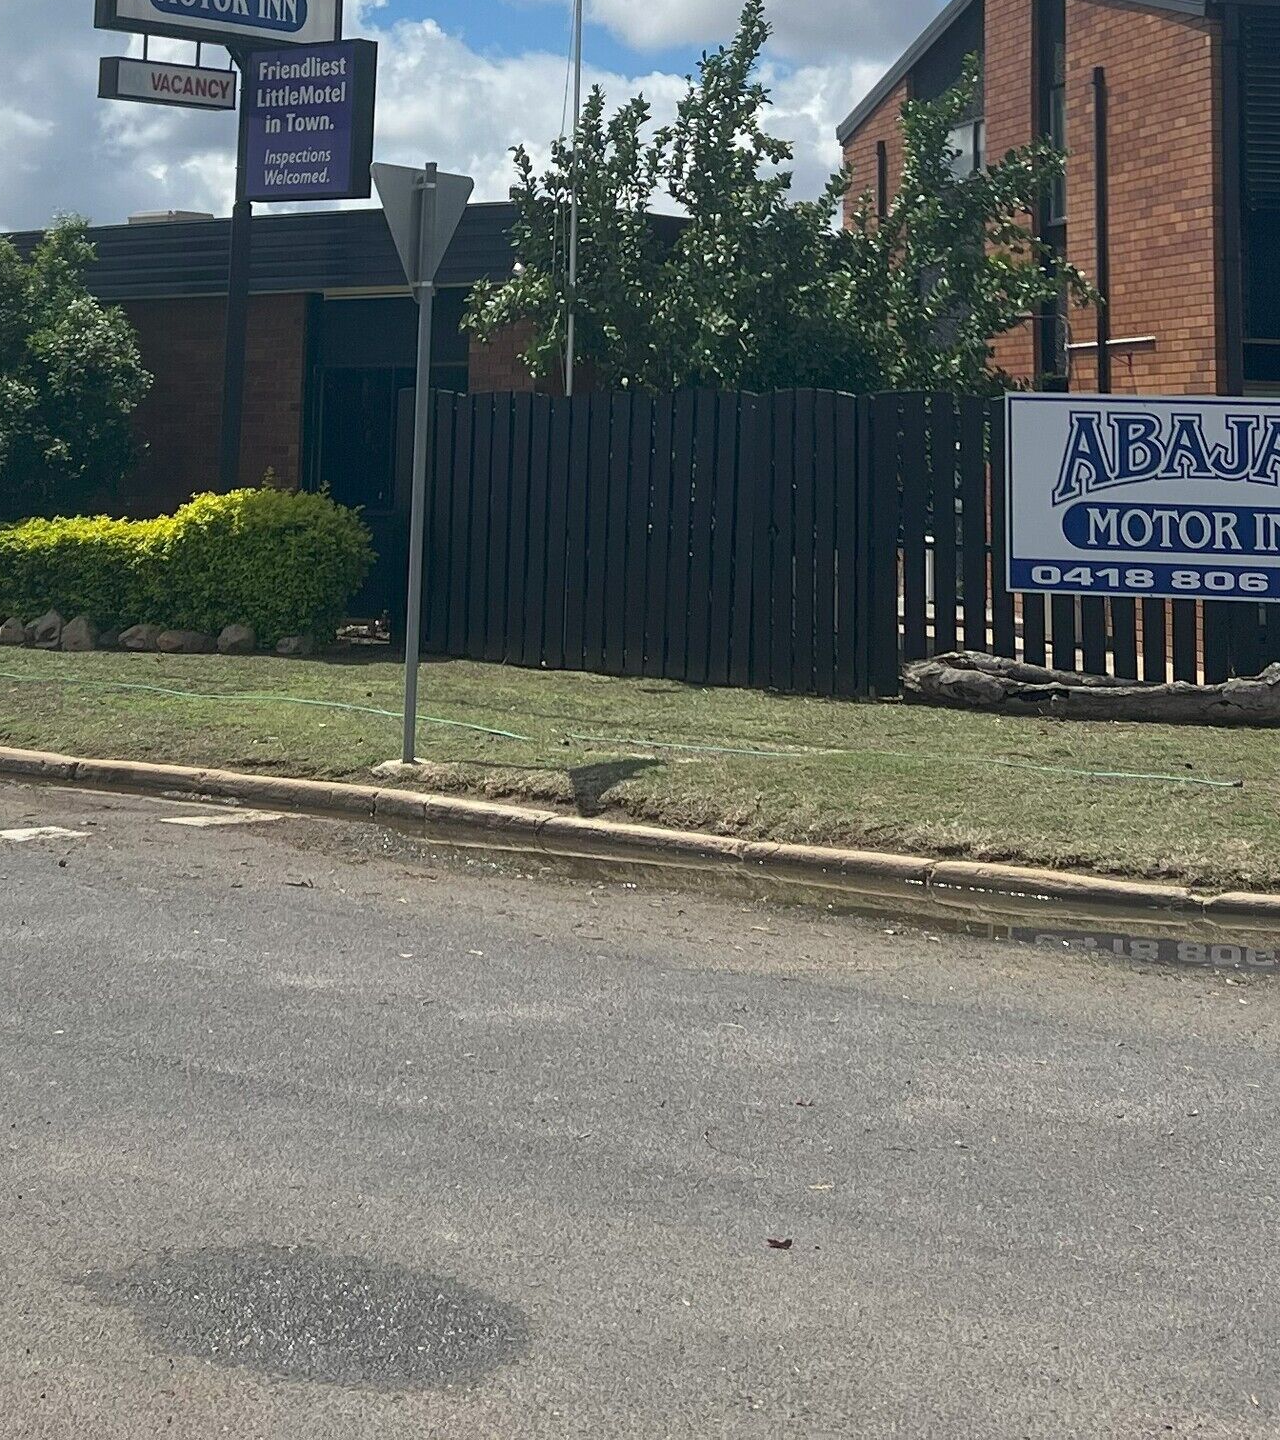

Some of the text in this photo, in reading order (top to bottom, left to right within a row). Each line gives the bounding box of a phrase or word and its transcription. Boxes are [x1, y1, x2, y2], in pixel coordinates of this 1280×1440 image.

[258, 56, 347, 81] Friendliest
[151, 71, 231, 100] VACANCY
[265, 111, 335, 134] in Town.
[264, 148, 332, 167] Inspections
[263, 166, 331, 186] Welcomed.
[1085, 507, 1243, 551] MOTOR
[1031, 565, 1155, 589] 0418
[1171, 569, 1269, 593] 806
